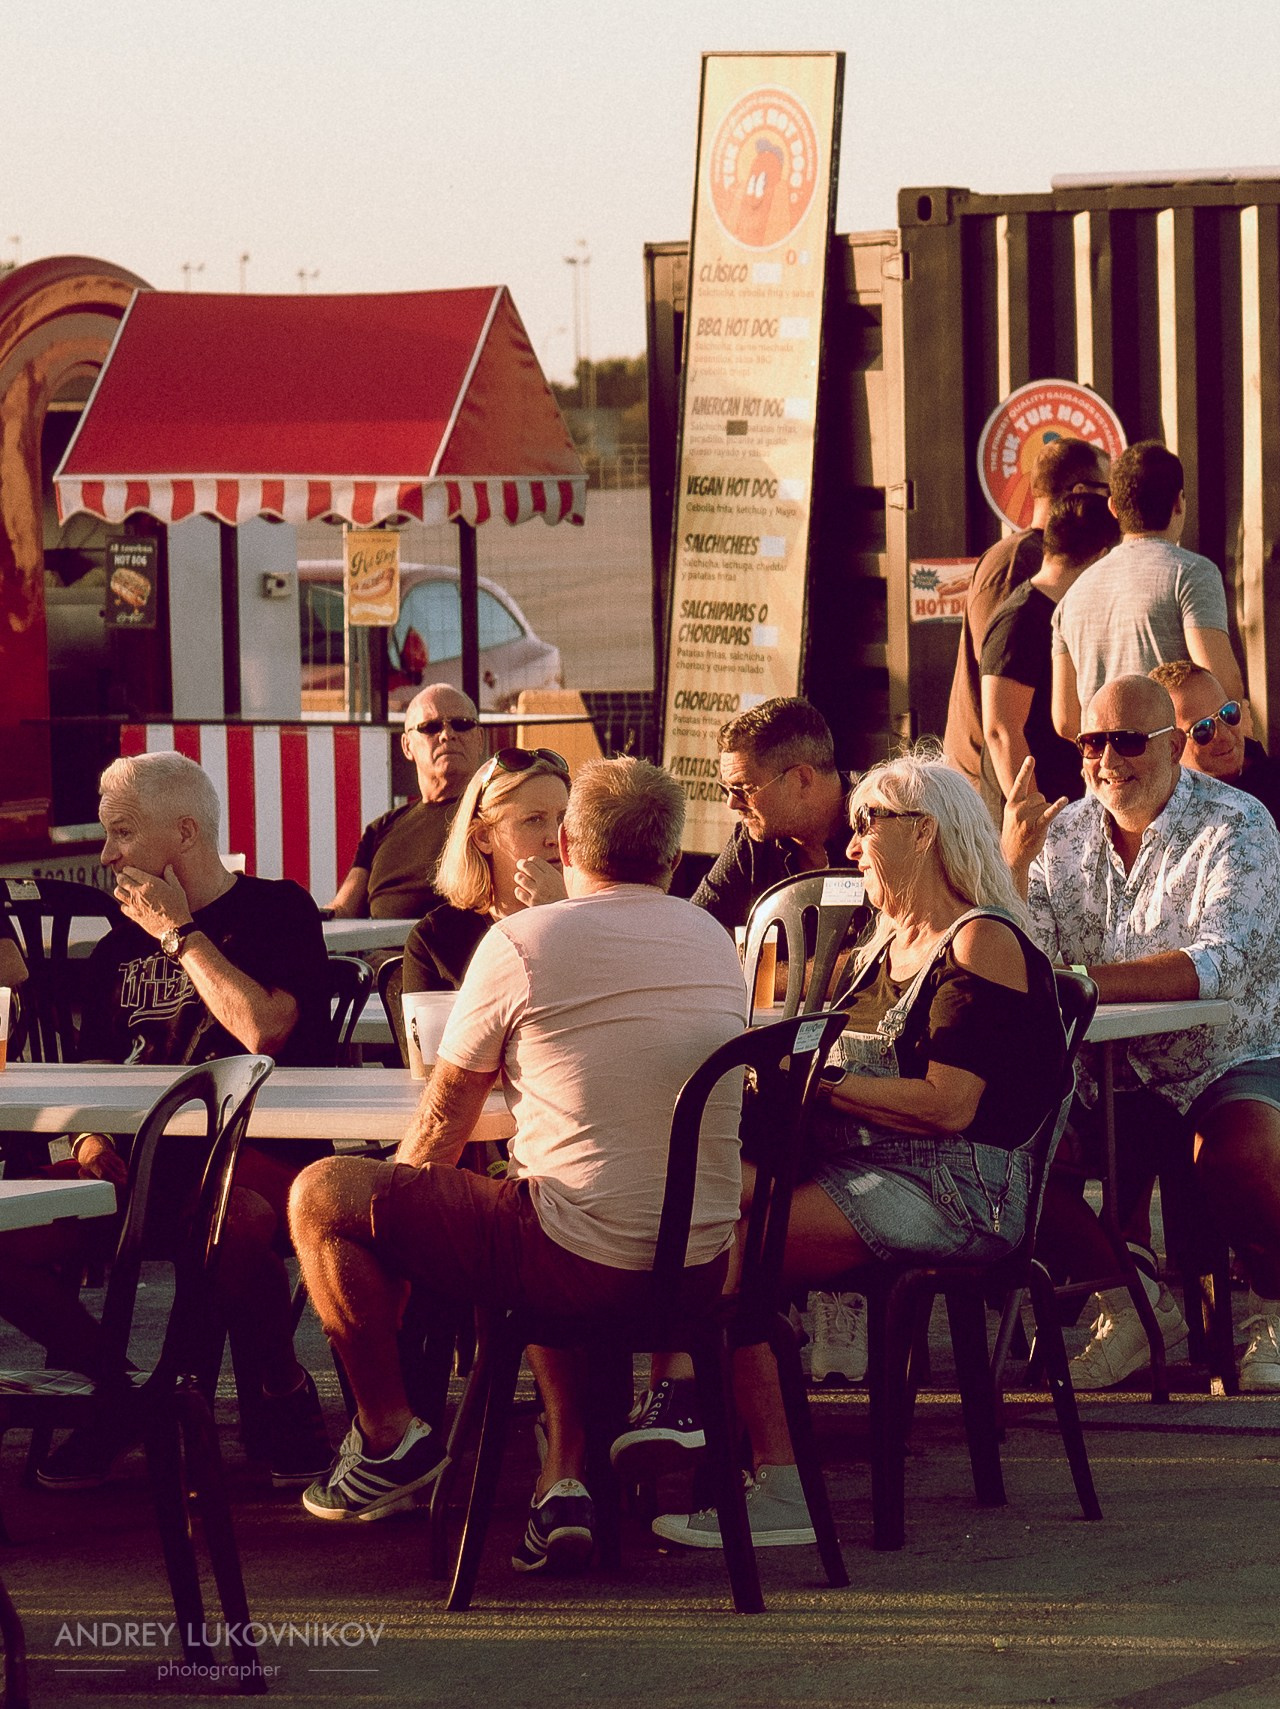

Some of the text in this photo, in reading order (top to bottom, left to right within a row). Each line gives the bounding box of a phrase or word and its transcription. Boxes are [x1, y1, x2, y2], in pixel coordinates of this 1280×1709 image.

[700, 256, 748, 282] CLÁSICO
[725, 318, 750, 336] HOT
[751, 319, 778, 338] DOG
[692, 396, 785, 418] AMERICAN HOT DOG
[1009, 393, 1045, 418] QUALITY
[1057, 404, 1096, 436] HOT
[686, 475, 778, 499] VEGAN HOT DOG
[684, 533, 759, 556] SALCHICHEES
[680, 600, 768, 623] SALCHIPAPAS O
[915, 599, 946, 616] HOT
[678, 623, 751, 646] CHORIPAPAS
[674, 690, 740, 713] CHORIPERO
[670, 756, 719, 778] PATATAS
[677, 779, 728, 801] ATURALE
